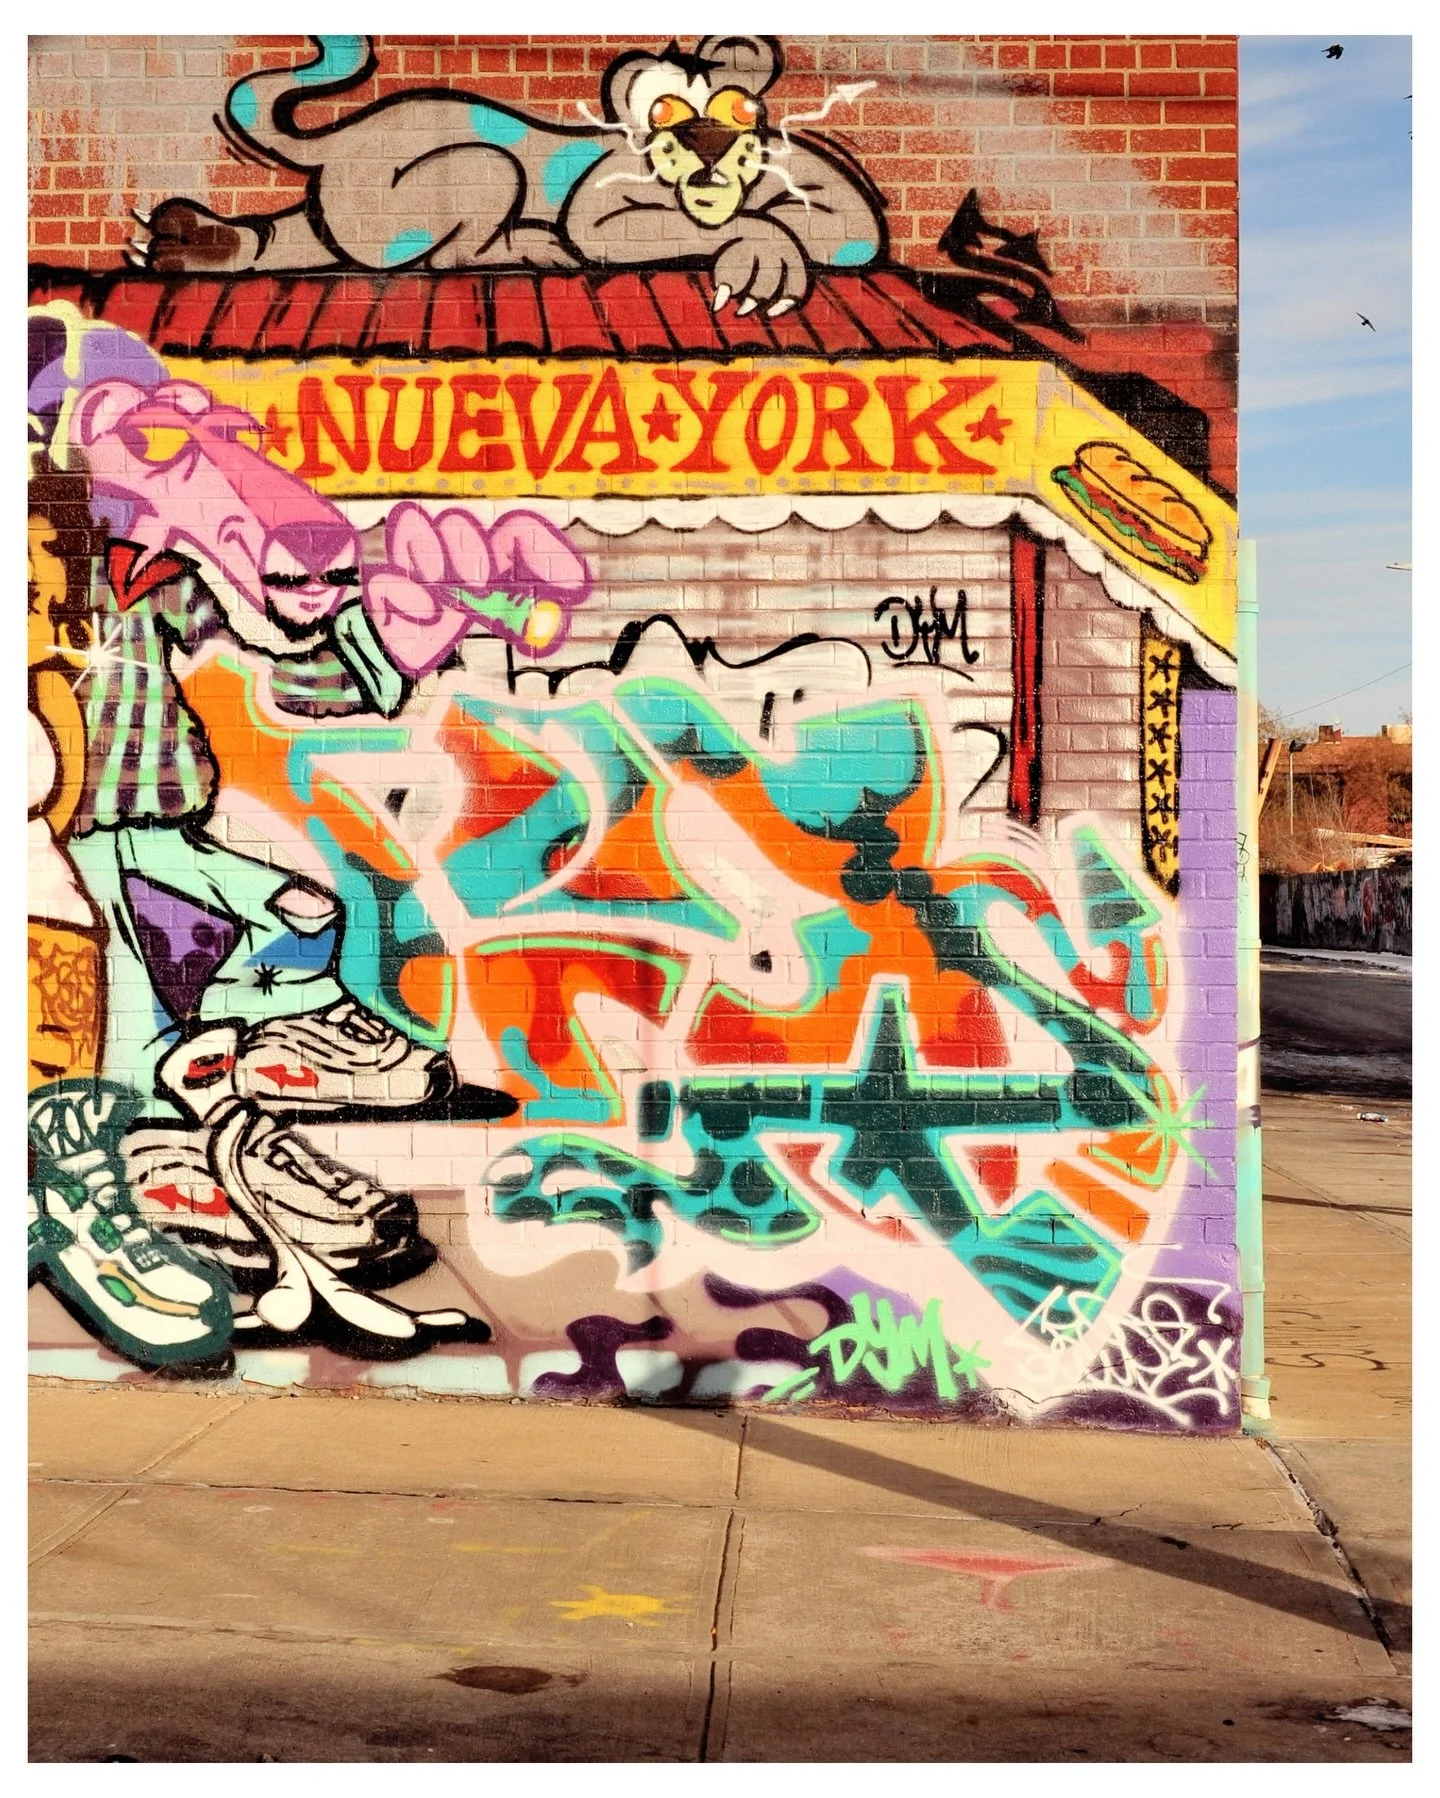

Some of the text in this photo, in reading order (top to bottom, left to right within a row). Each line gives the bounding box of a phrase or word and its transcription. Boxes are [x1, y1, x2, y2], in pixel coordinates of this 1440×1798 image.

[294, 364, 998, 480] NUEVA YORK
[808, 1291, 959, 1401] DYM
